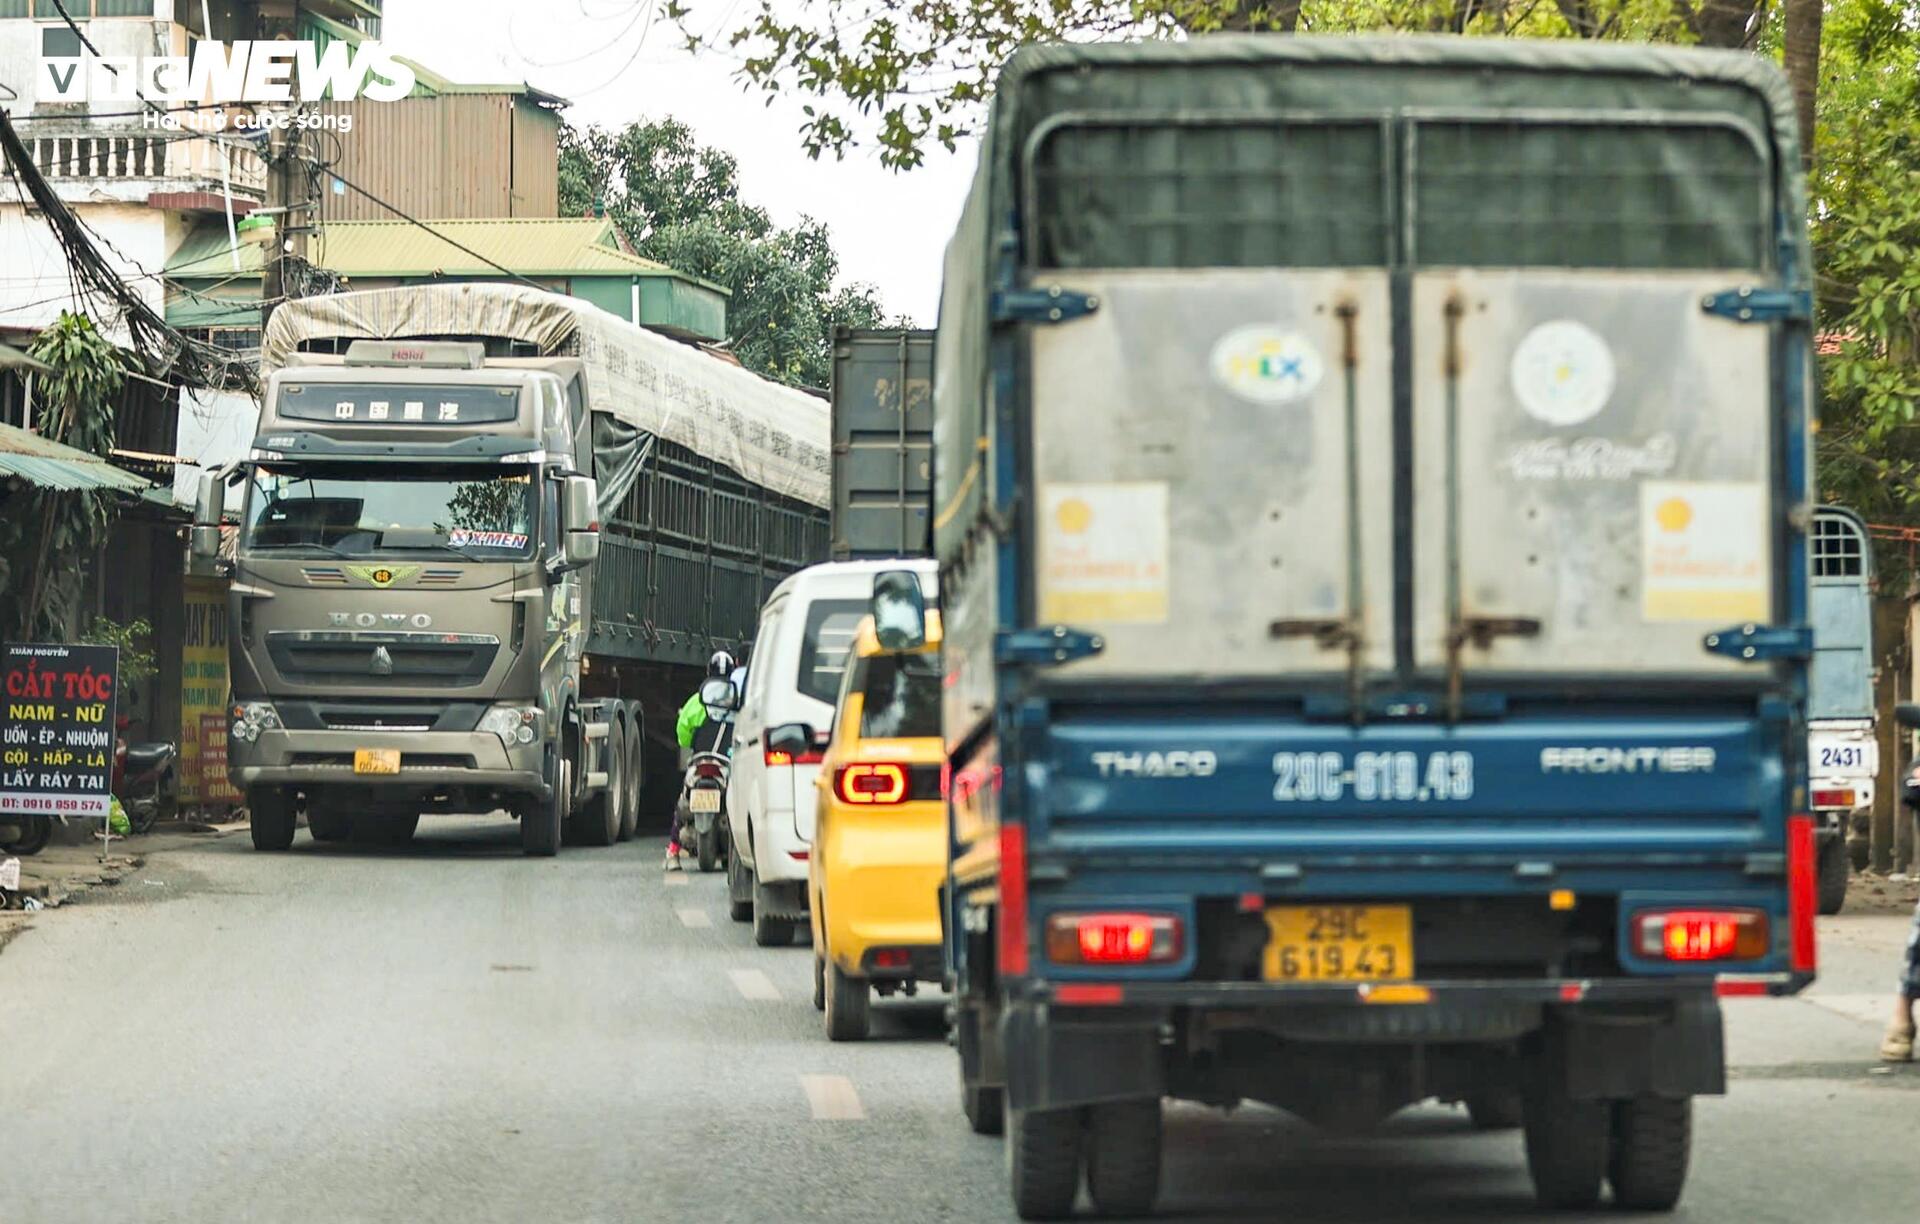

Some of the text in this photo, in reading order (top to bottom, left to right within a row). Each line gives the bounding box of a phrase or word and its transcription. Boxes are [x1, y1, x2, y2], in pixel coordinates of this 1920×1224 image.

[470, 532, 527, 548] X-MEN
[328, 612, 432, 628] HOWO
[6, 657, 112, 700] CẮT TÓC
[9, 704, 55, 721] NAM
[75, 703, 106, 722] NỮ
[4, 724, 28, 744] UỐN
[66, 728, 109, 749] NHUỘM
[4, 748, 29, 766] GỘI
[43, 748, 73, 766] HẤP
[87, 750, 105, 767] LÀ
[1092, 751, 1218, 777] THACO
[1540, 747, 1716, 774] FRONTIER
[1821, 747, 1863, 767] 2431
[3, 768, 104, 789] LẤY RÁY TAI
[23, 799, 52, 809] 0916
[81, 801, 102, 811] 574
[1306, 907, 1368, 940] 29C
